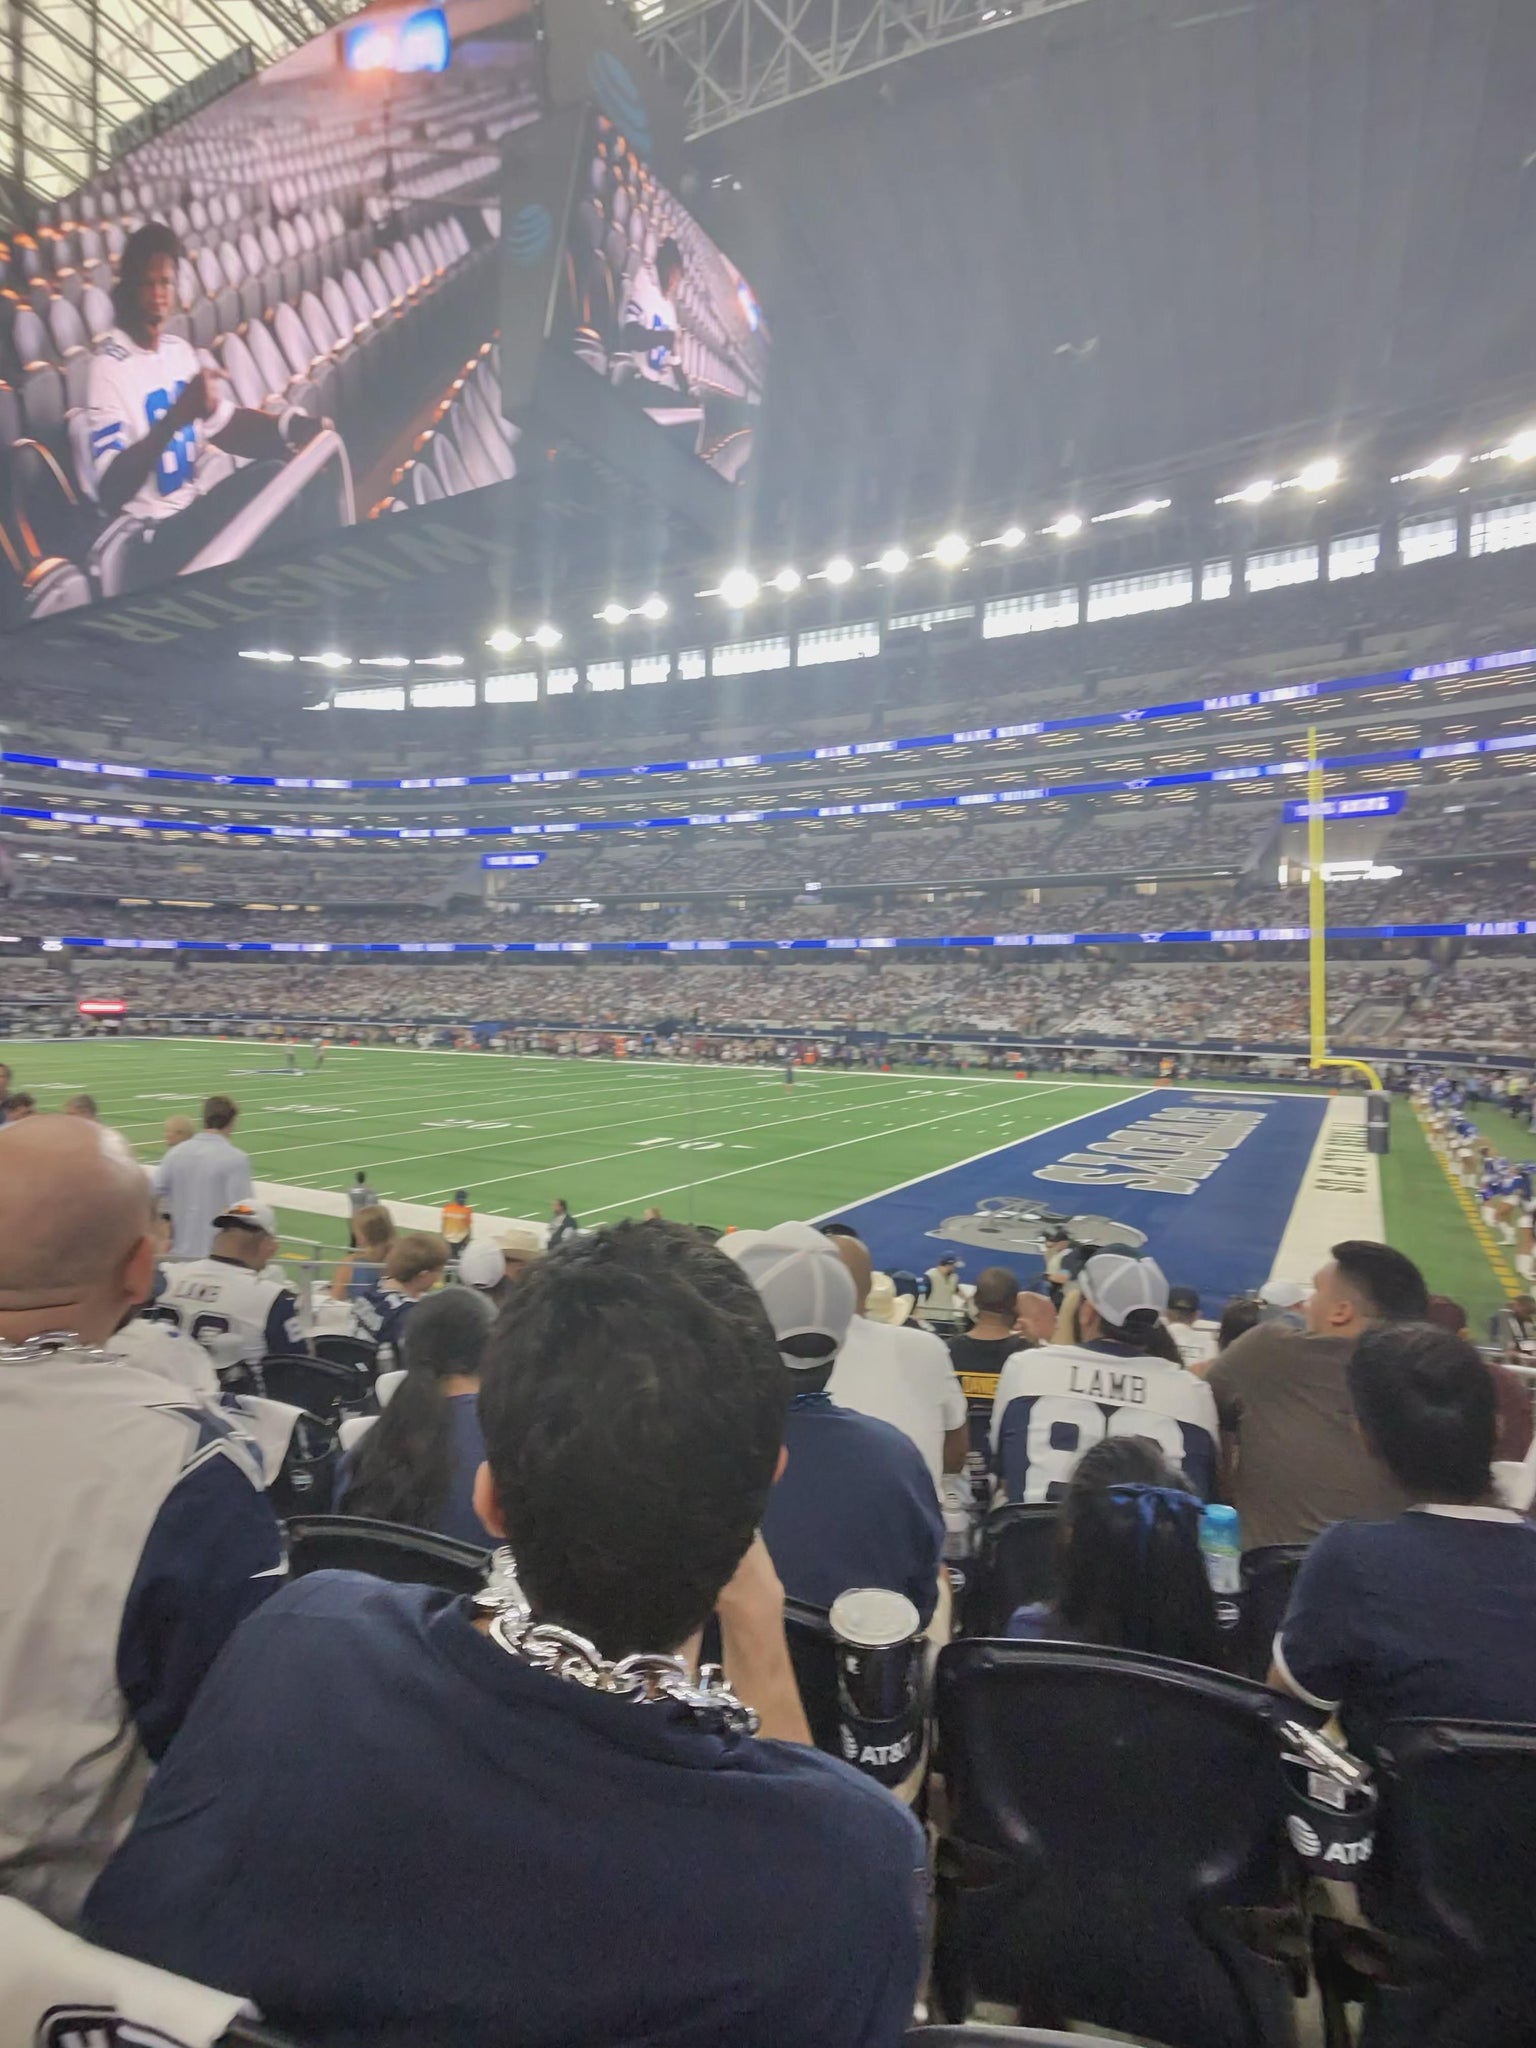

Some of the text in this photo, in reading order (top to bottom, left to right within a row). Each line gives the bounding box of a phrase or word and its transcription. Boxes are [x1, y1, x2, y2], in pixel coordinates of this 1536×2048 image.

[80, 523, 508, 643] WINSTAR
[1032, 1107, 1267, 1196] COWBOYS
[1322, 1147, 1368, 1162] ALL
[1319, 1164, 1367, 1177] OF
[1313, 1178, 1367, 1194] US
[1067, 1364, 1148, 1404] LAMB
[1323, 1836, 1375, 1865] AT&
